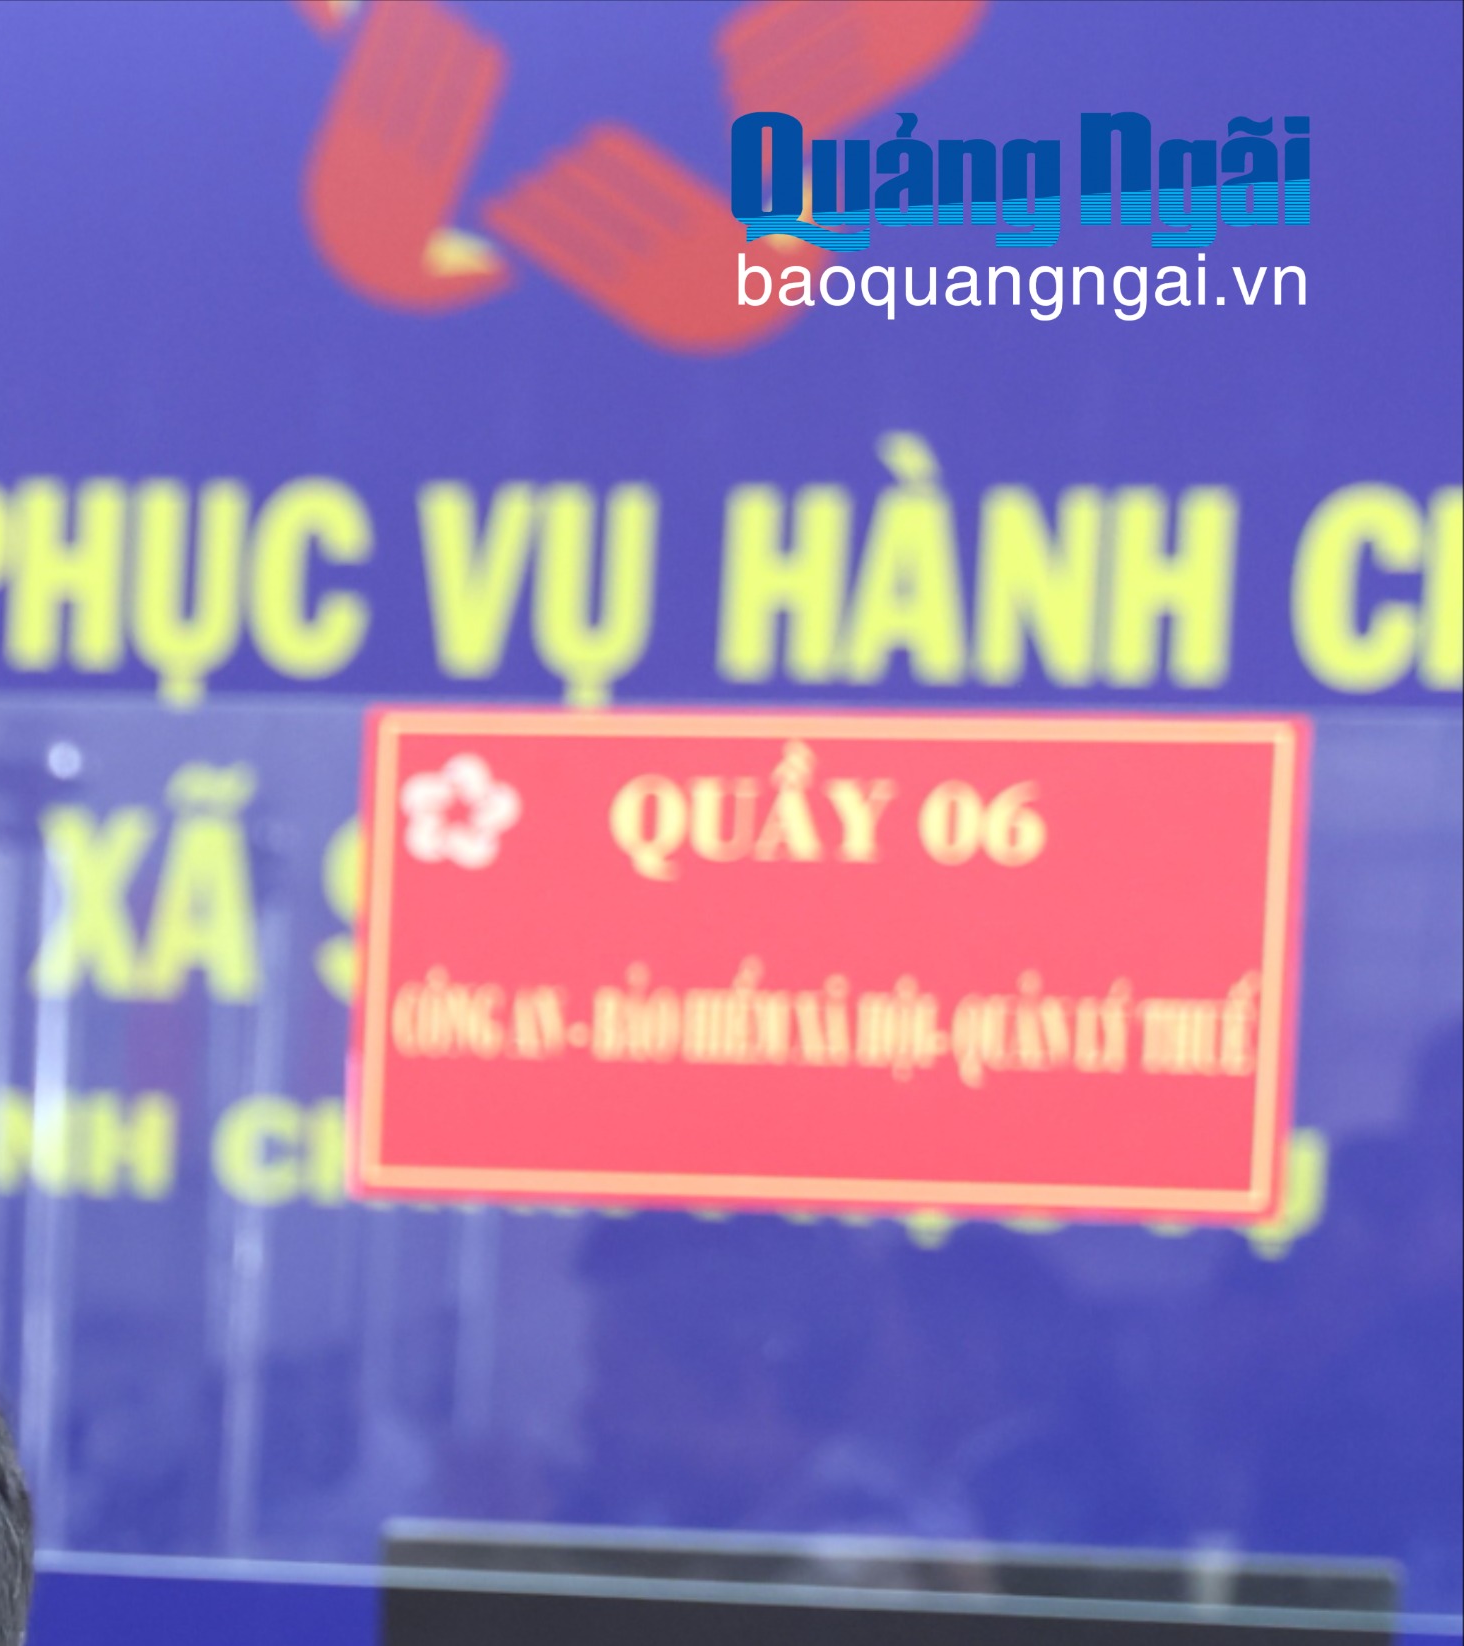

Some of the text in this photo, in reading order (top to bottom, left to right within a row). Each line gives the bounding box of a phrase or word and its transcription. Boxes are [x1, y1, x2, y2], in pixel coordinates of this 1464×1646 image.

[415, 478, 658, 713] VỤ
[717, 430, 1241, 691] HÀNH
[27, 760, 261, 1005] XÃ
[609, 739, 1048, 880] QUẦY 06
